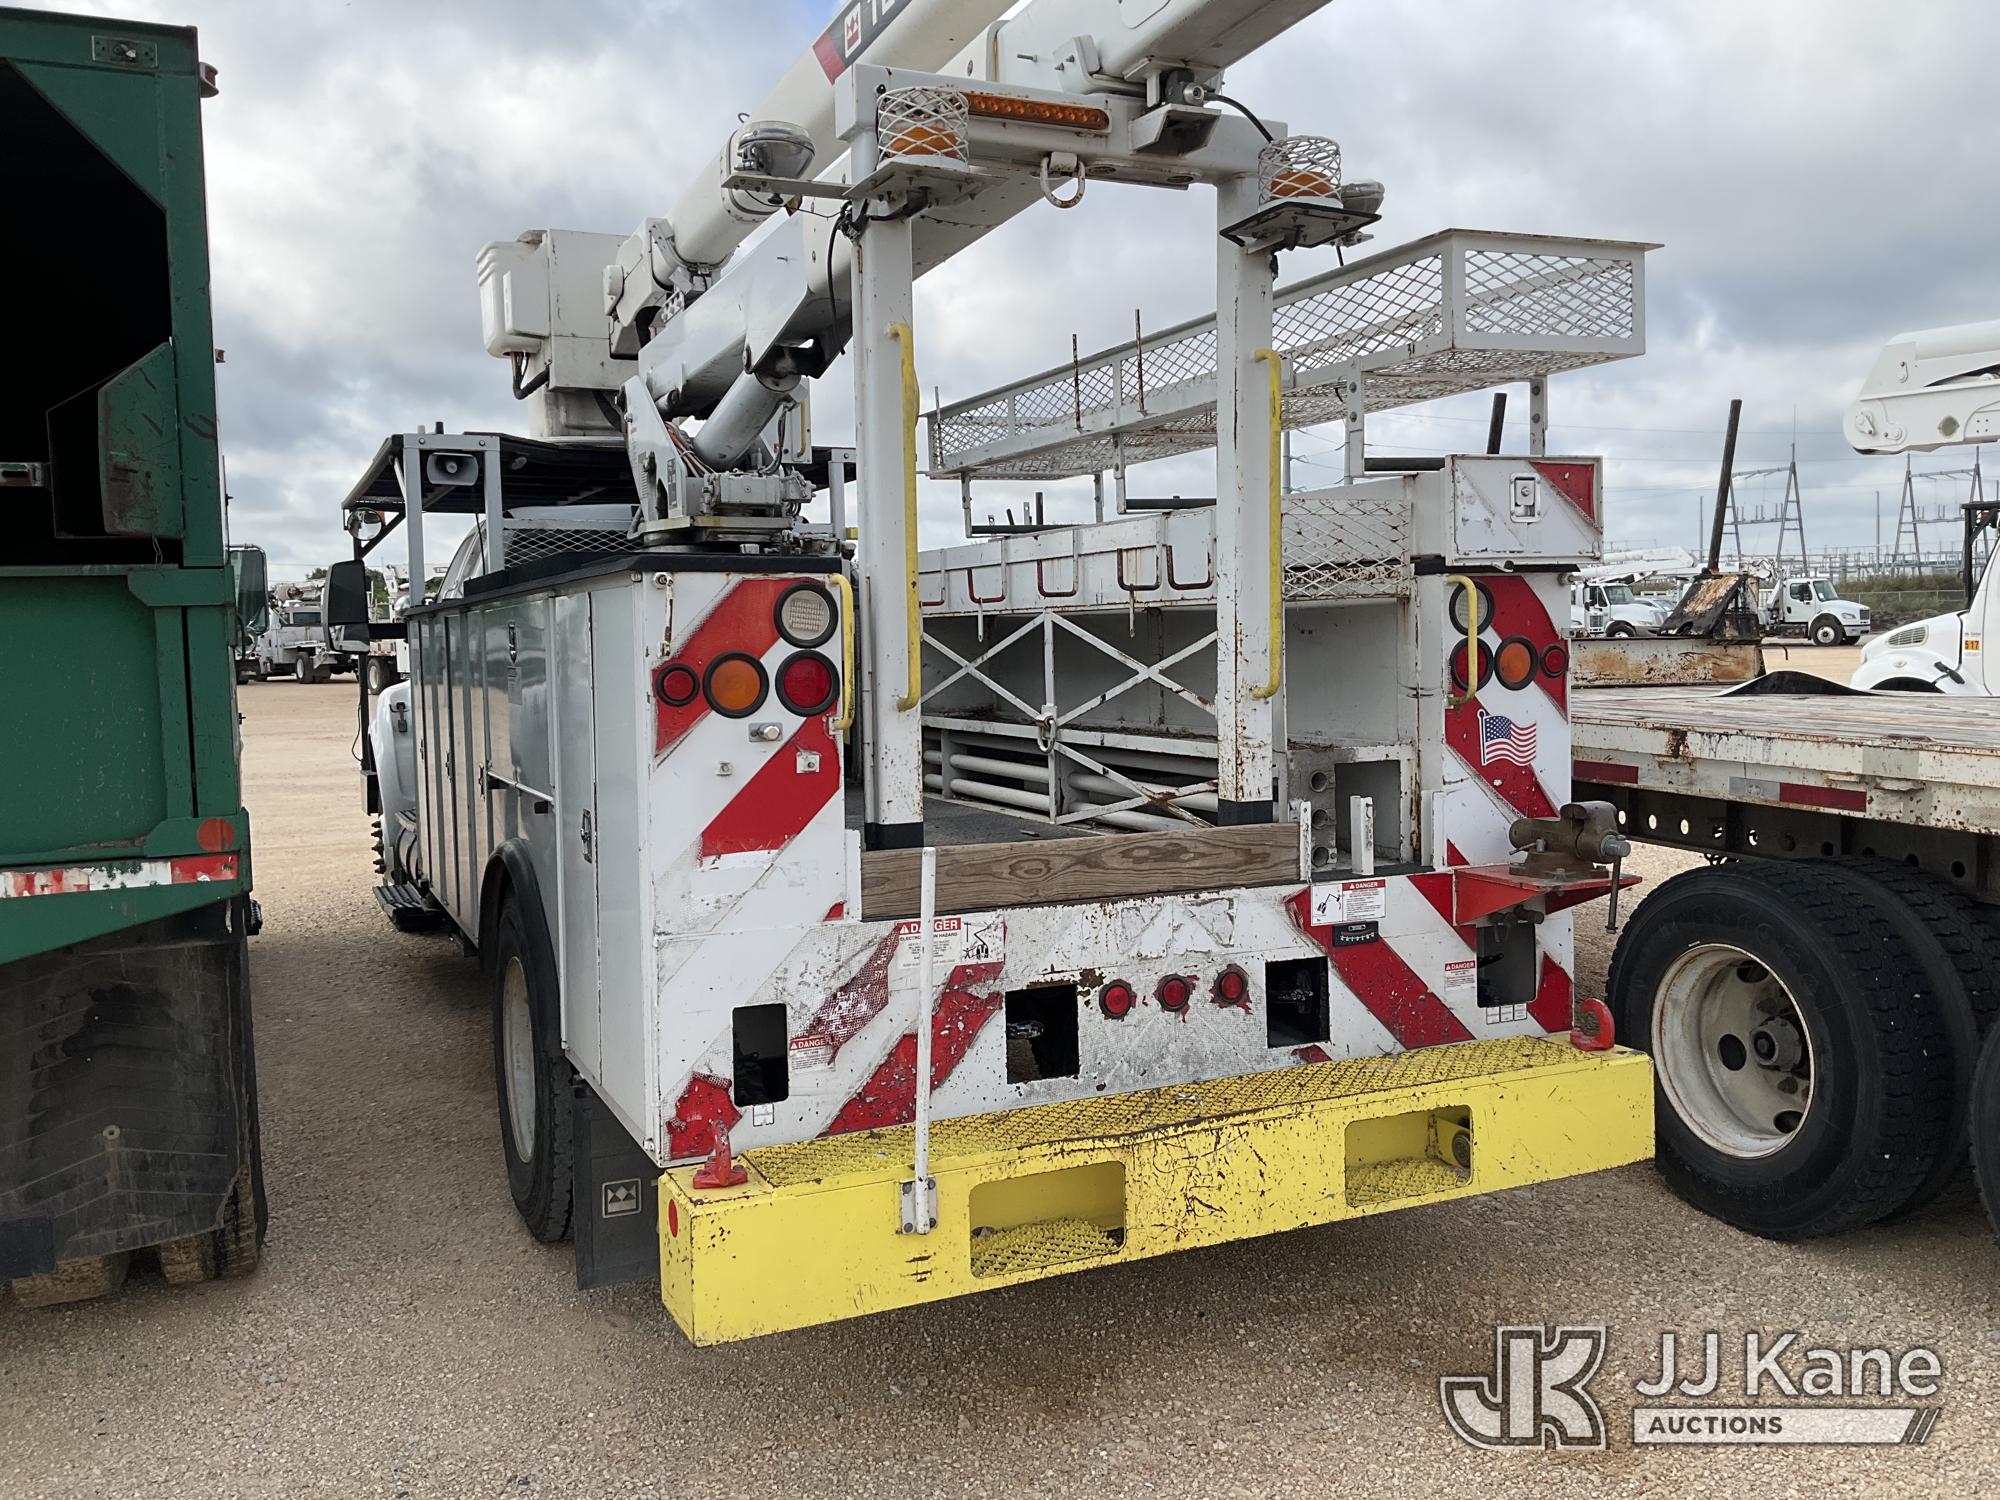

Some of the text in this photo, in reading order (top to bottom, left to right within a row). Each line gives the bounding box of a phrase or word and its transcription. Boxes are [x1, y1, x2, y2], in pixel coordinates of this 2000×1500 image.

[1964, 640, 1980, 650] 517
[1355, 881, 1378, 889] DANGER
[910, 919, 958, 933] DGER
[1451, 961, 1475, 969] DANGER
[798, 1039, 826, 1049] DANGE
